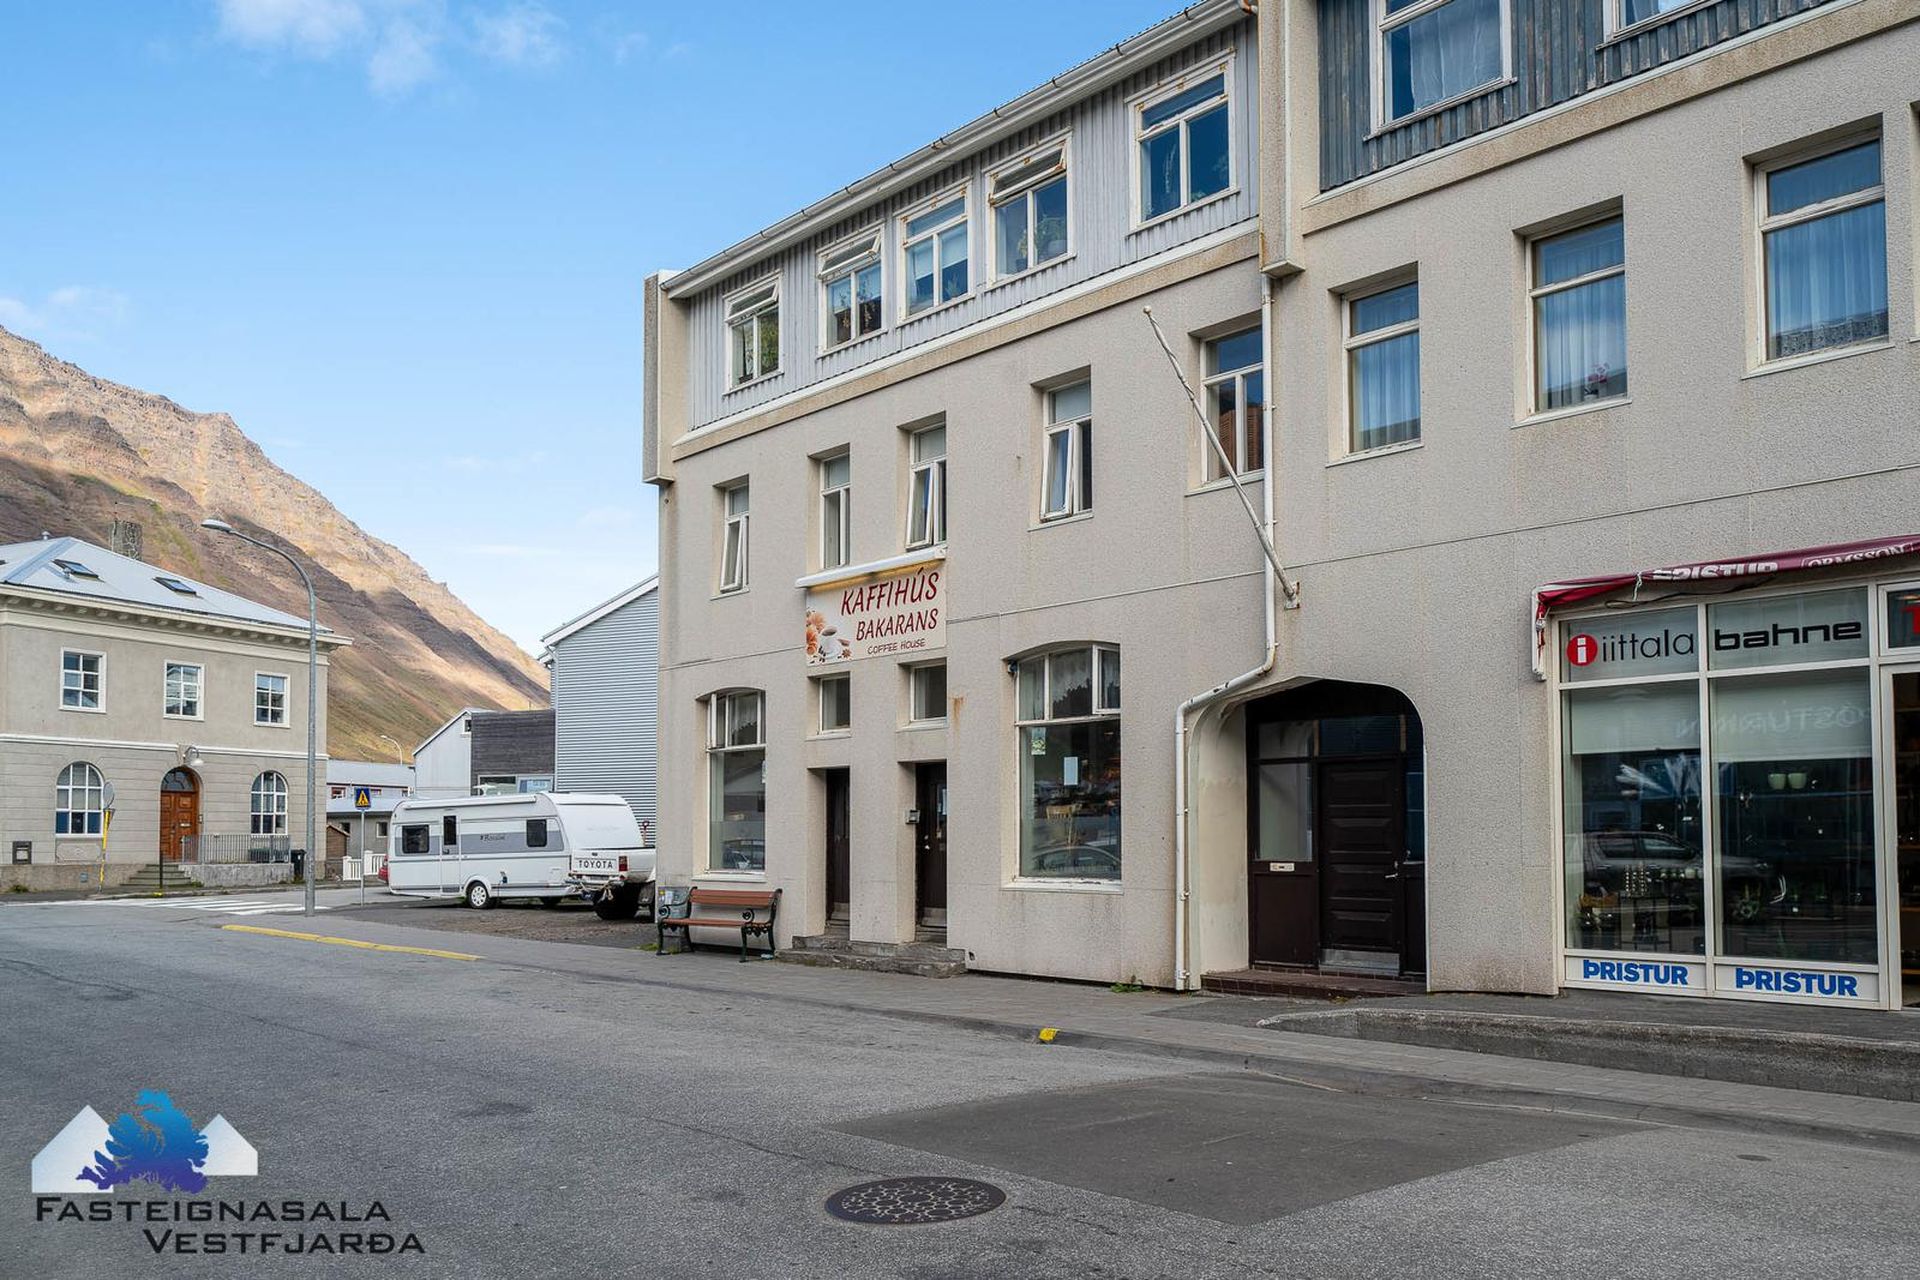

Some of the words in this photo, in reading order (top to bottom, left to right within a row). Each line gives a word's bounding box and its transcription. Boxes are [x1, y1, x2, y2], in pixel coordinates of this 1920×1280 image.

[841, 567, 939, 616] KAFFIHÚS
[856, 608, 938, 641] BAKARANS
[1715, 621, 1861, 651] bahne
[867, 642, 898, 655] COFFEE
[900, 638, 926, 650] HOUSE
[1602, 629, 1694, 662] iittala
[579, 860, 613, 869] TOYOTA
[1583, 959, 1688, 985] ÞRISTUR
[1735, 967, 1858, 997] ÞRISTUR
